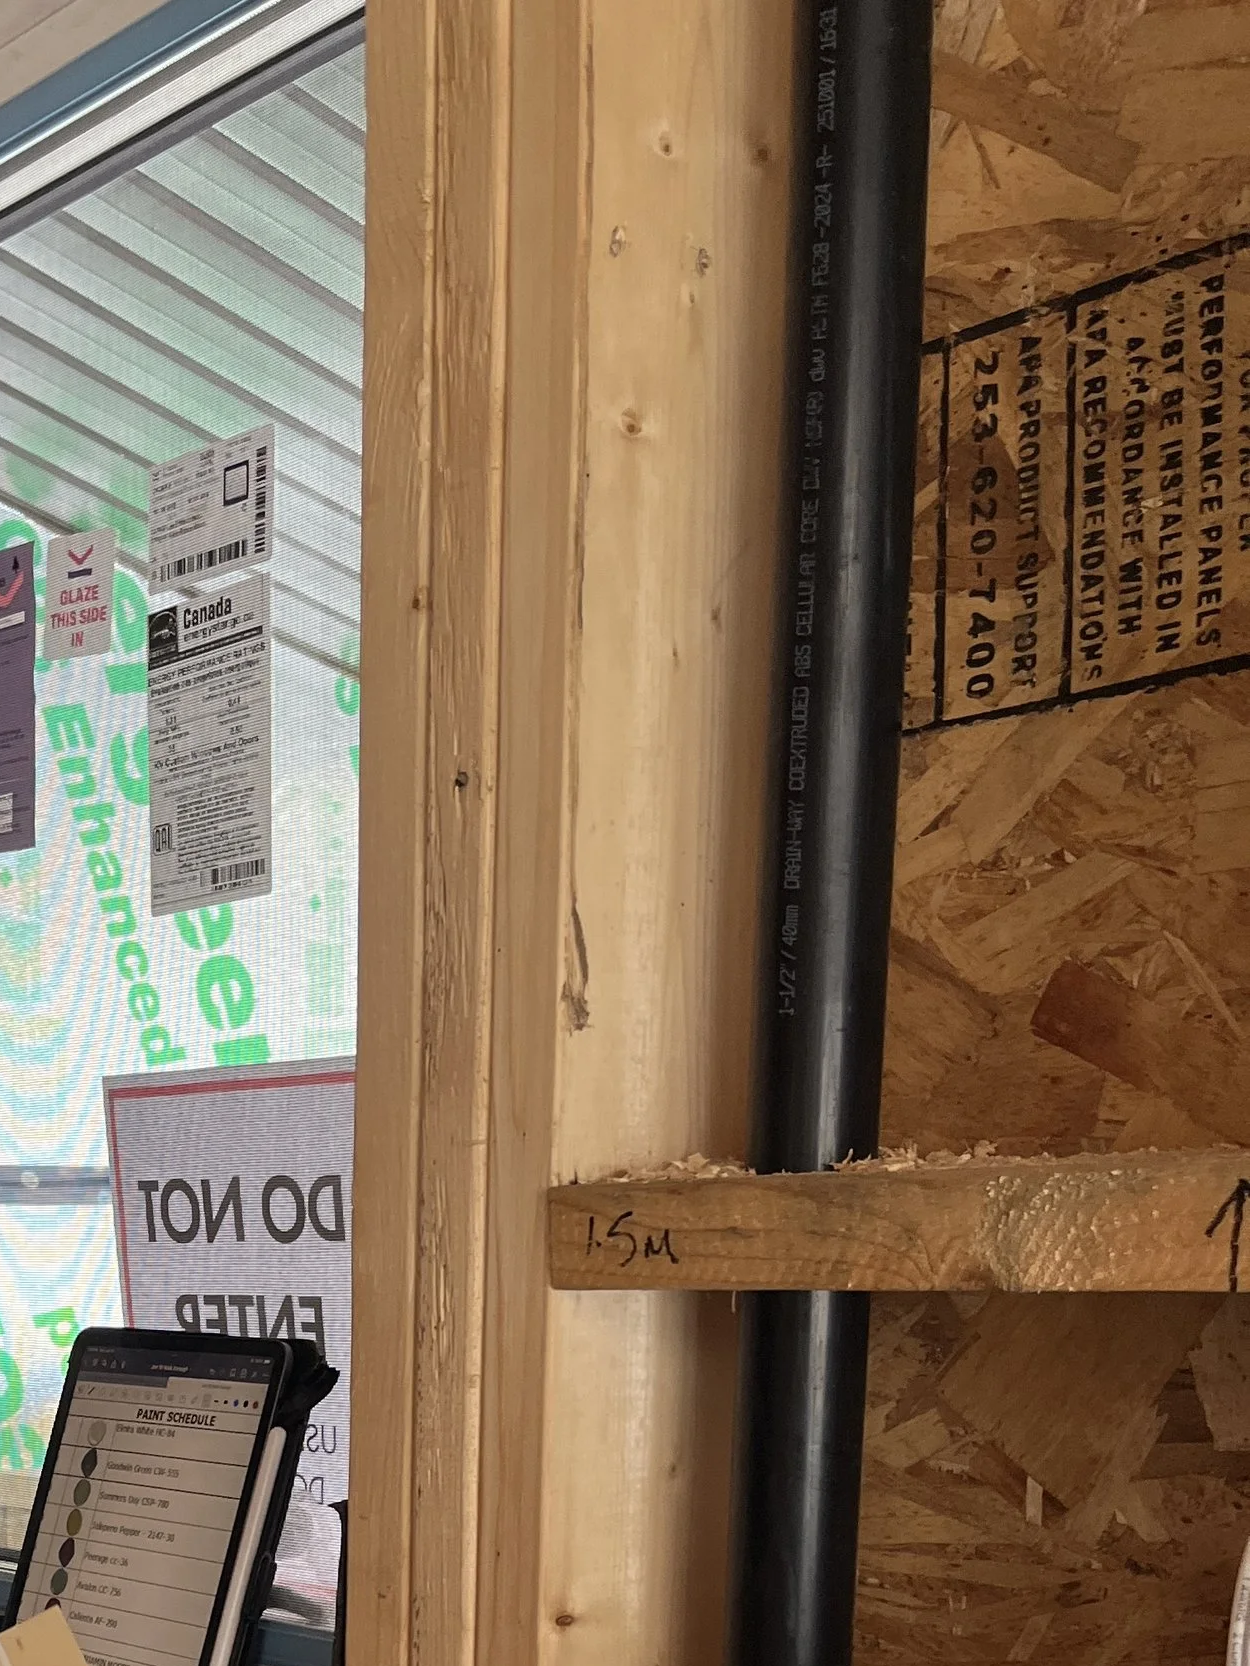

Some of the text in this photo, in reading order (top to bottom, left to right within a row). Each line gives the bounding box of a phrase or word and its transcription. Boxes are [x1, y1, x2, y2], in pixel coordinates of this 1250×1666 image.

[1158, 388, 1185, 425] BE
[1195, 273, 1227, 649] PERFORMANCE PANELS
[799, 500, 818, 542] CORE
[964, 350, 1002, 700] 253-620-7400
[1078, 379, 1110, 682] RECOMMENDATIONS
[1155, 438, 1185, 612] INSTALLED
[60, 585, 99, 606] GLAZE
[183, 596, 232, 629] Canada
[1115, 561, 1145, 637] WITH
[50, 606, 107, 628] THIS SIDE
[1010, 550, 1040, 689] SUPPORT
[71, 631, 83, 646] IN
[1154, 624, 1180, 655] IN
[793, 644, 812, 677] ABS
[789, 686, 810, 791] COEXTRUDED
[41, 702, 187, 1067] Enhanced
[136, 1408, 217, 1427] PAINT SCHEDULE
